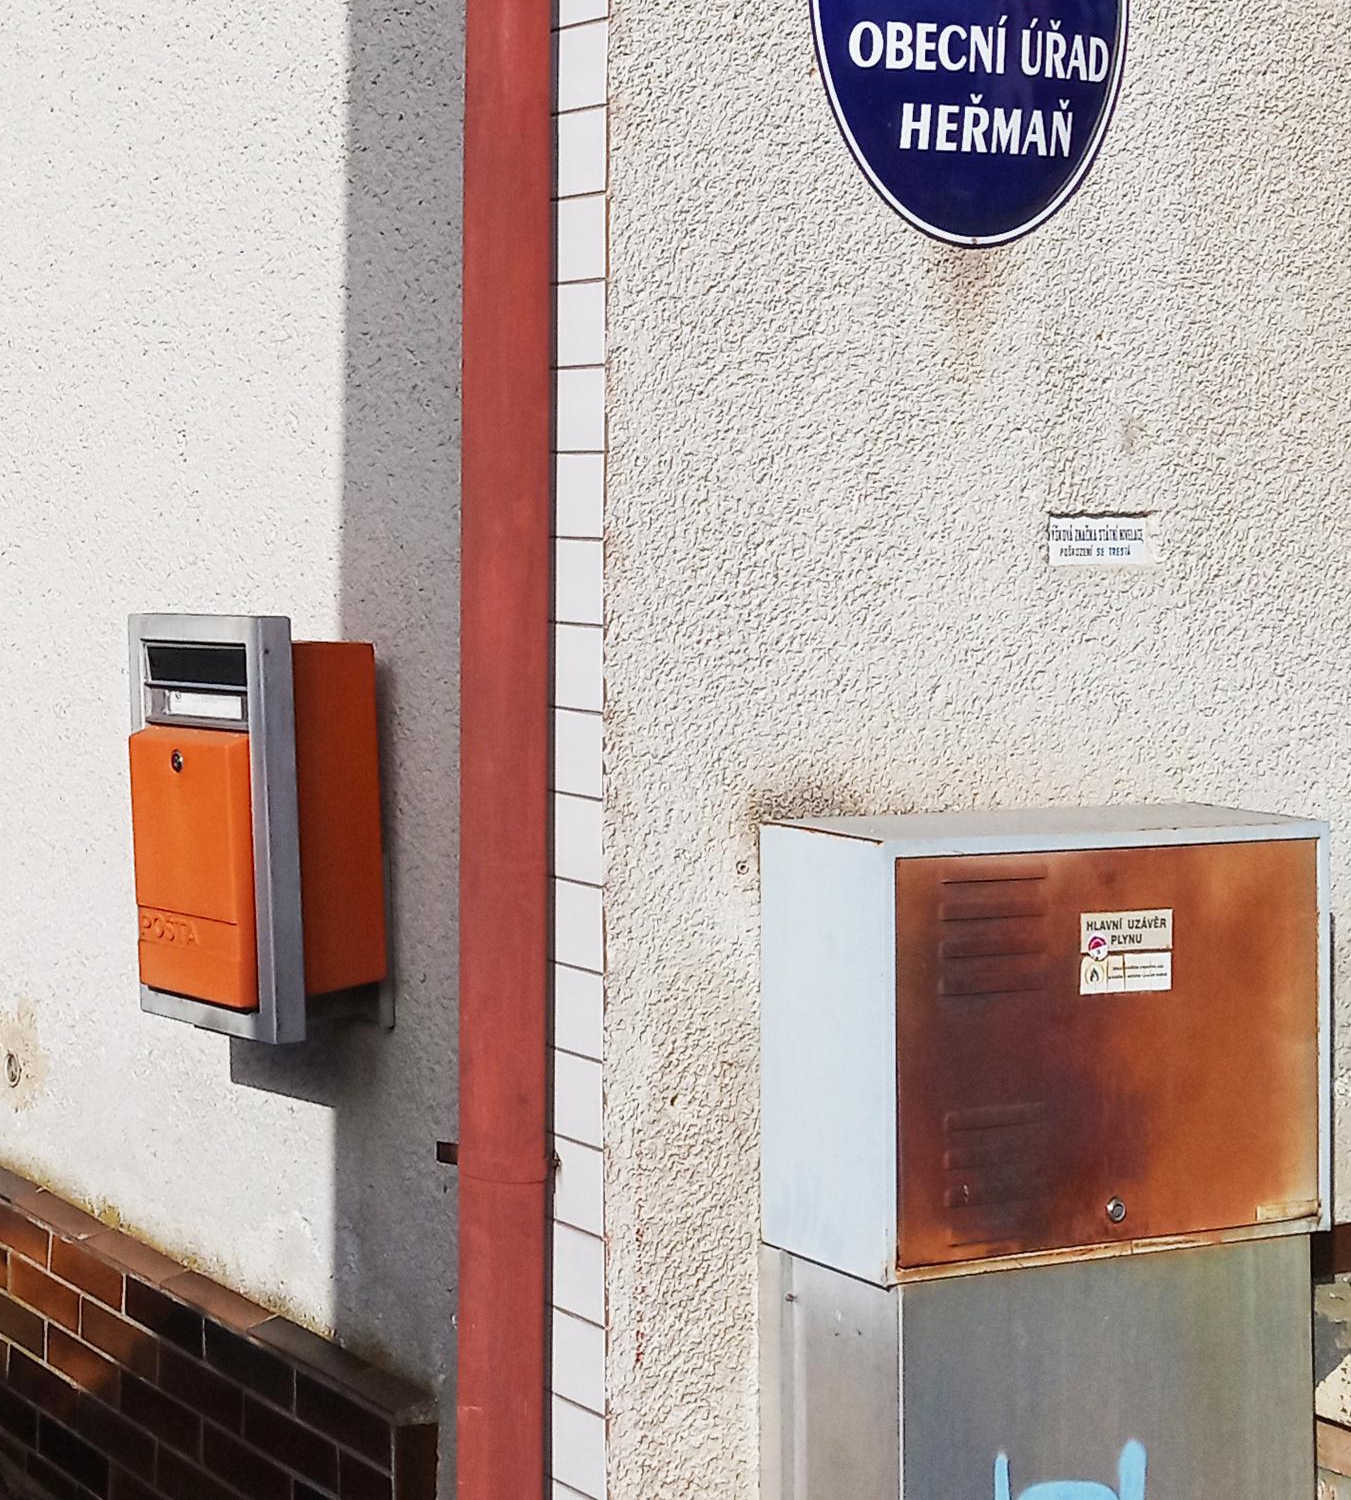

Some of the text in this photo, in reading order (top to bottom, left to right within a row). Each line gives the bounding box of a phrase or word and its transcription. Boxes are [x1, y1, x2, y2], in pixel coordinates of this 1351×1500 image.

[849, 15, 1110, 84] OBECNÍ ÚŘAD
[899, 93, 1073, 159] HEŘMAŇ
[1096, 547, 1105, 557] SE
[1086, 916, 1167, 931] HLAVNÍ UZÁVĚR
[1110, 934, 1143, 945] PLYNU
